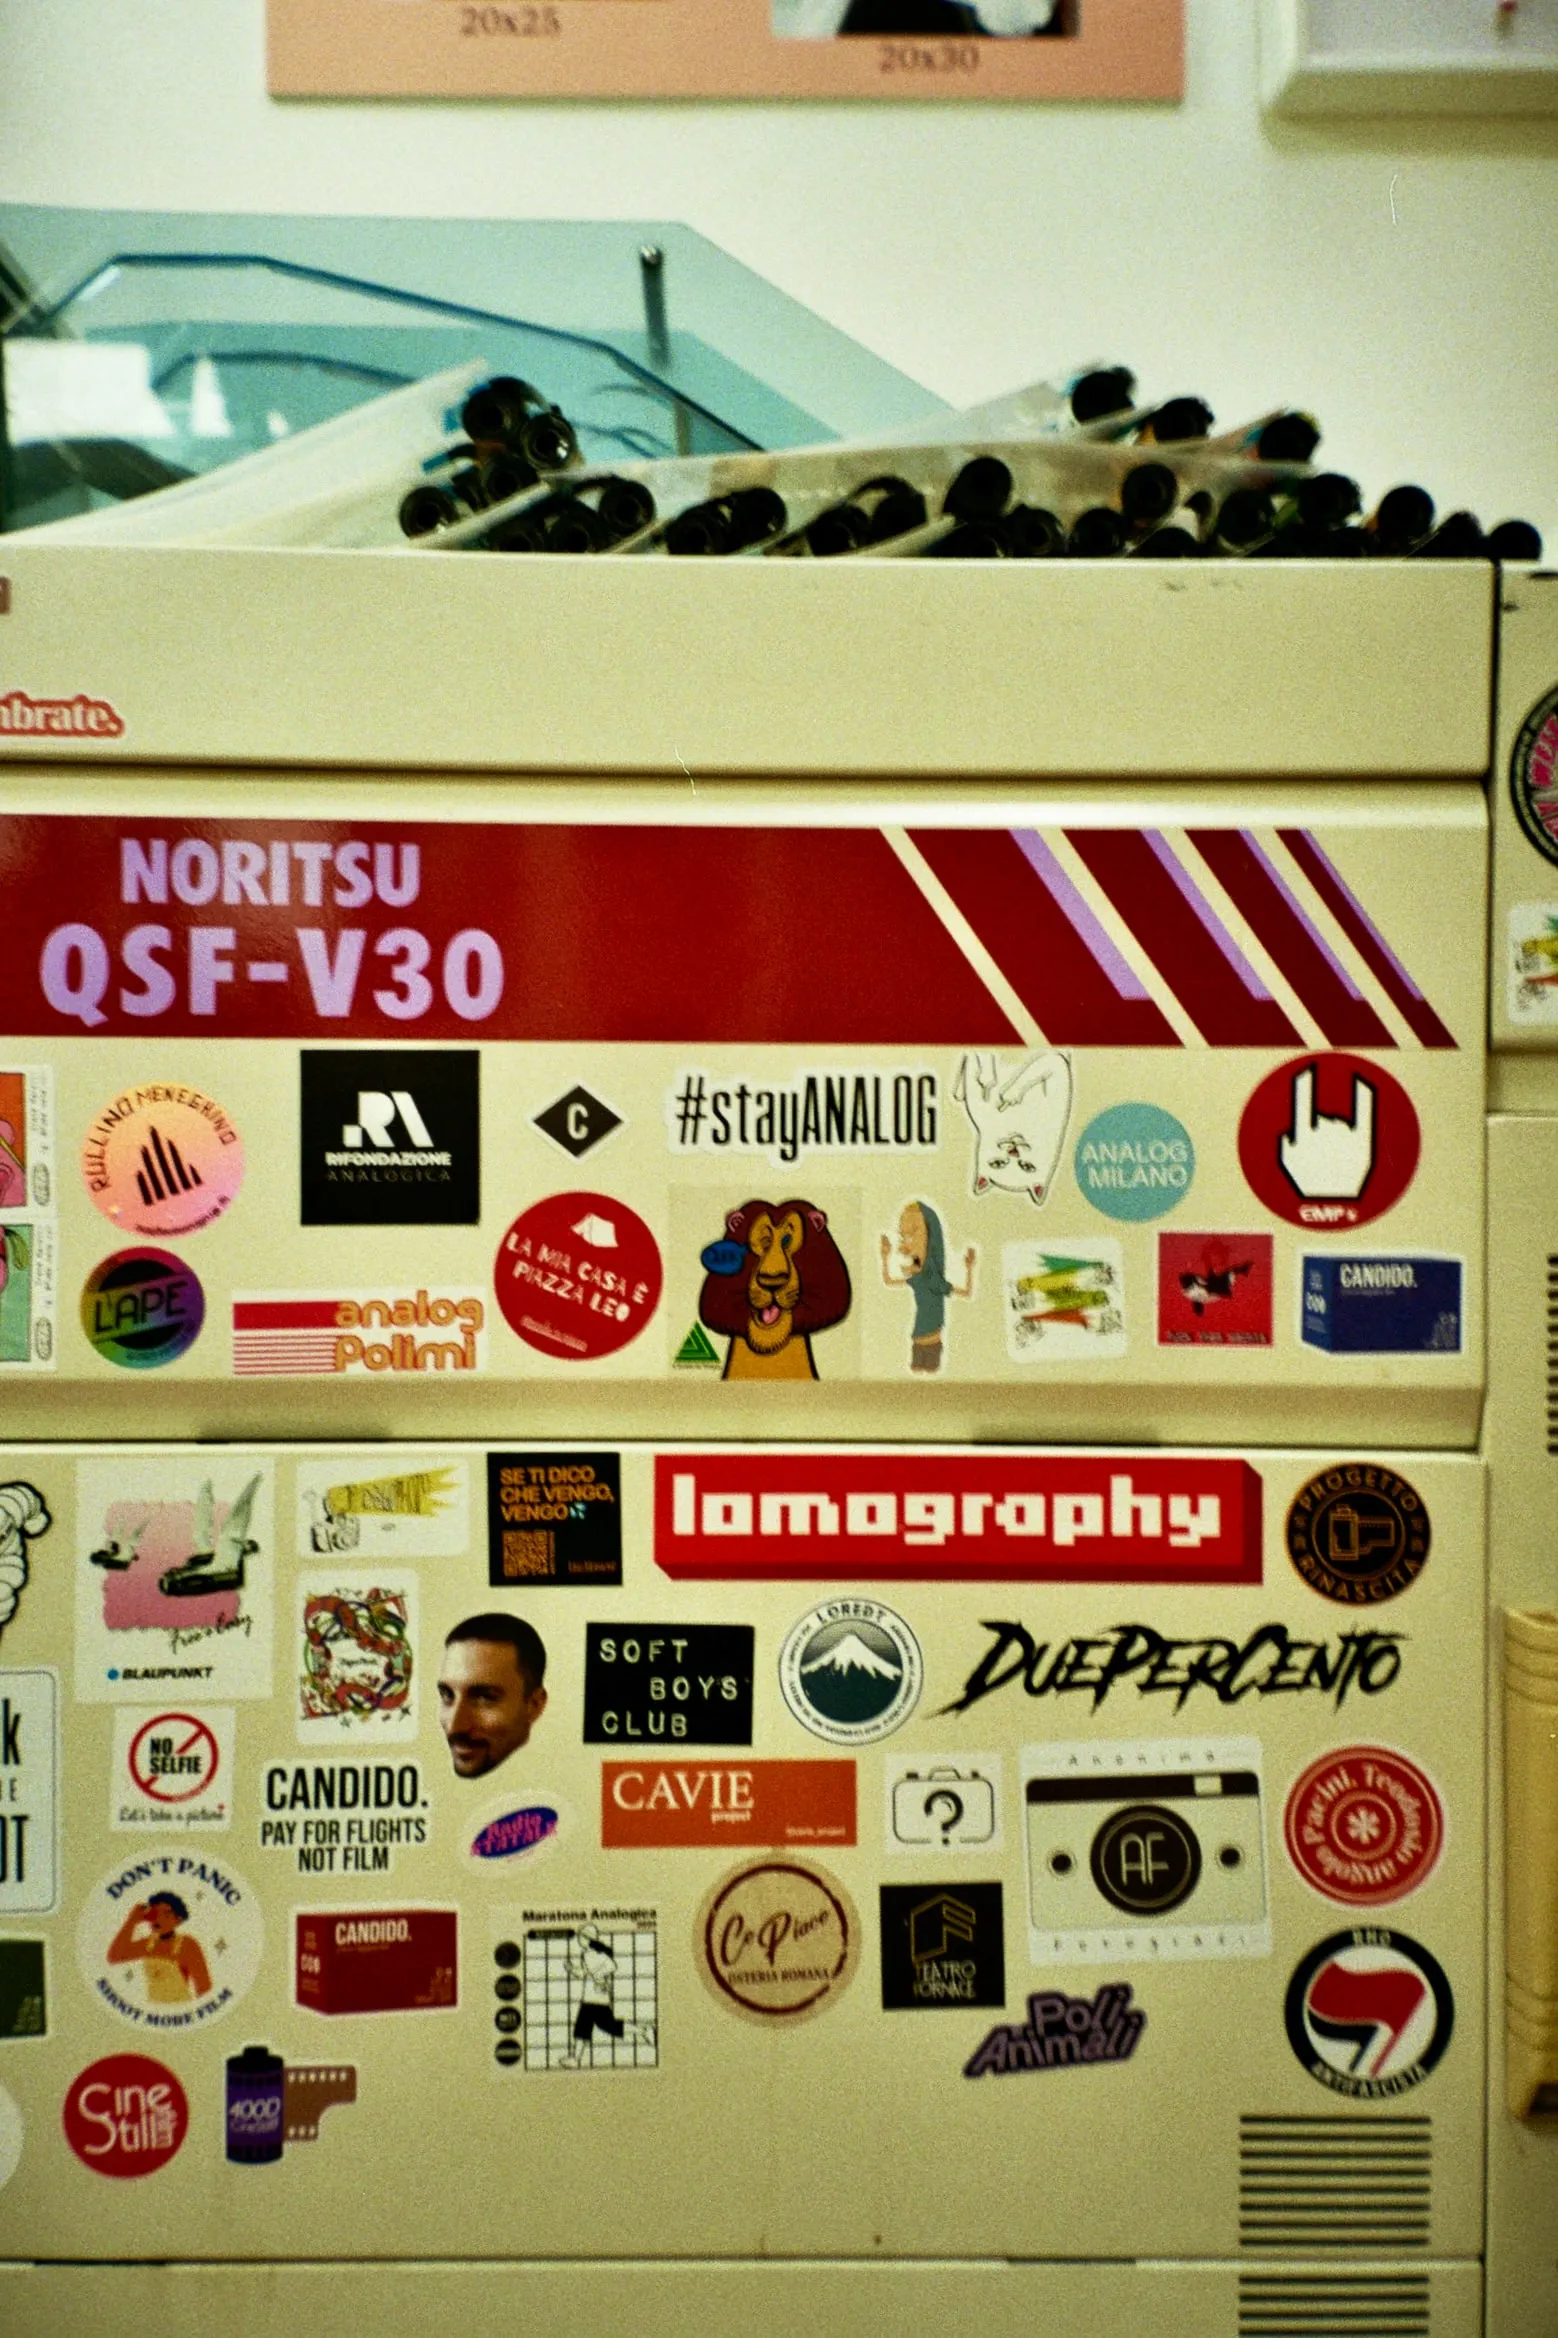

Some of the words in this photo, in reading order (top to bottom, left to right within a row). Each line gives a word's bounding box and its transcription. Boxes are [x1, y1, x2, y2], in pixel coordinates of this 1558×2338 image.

[460, 6, 561, 37] 20x25
[880, 42, 981, 73] 20x30
[119, 838, 420, 908] NORITSU
[39, 922, 505, 1027] QSF-V30
[566, 1102, 590, 1142] C
[674, 1074, 938, 1162] #stayANALOG
[84, 1097, 135, 1193] RULLINO
[324, 1151, 452, 1167] RIFONDAZIONE
[1082, 1139, 1189, 1164] ANALOG
[326, 1168, 451, 1183] ANALOGICA
[1088, 1164, 1189, 1189] MILANO
[505, 1230, 533, 1258] LA
[537, 1242, 572, 1275] MIA
[577, 1260, 627, 1297] CASA
[1339, 1262, 1418, 1289] CANDIDO.
[512, 1259, 585, 1306] PIAZZA
[588, 1292, 631, 1323] LEO
[334, 1289, 485, 1334] analog
[500, 1466, 527, 1486] SE
[527, 1465, 546, 1485] TI
[548, 1464, 596, 1484] DICO
[1299, 1468, 1419, 1512] PROGETTO
[500, 1484, 541, 1505] CHE
[500, 1502, 569, 1522] VENGO
[672, 1472, 1222, 1548] lomography
[1300, 1555, 1421, 1601] RINASCITA
[600, 1637, 689, 1664] SOFT
[121, 1666, 214, 1680] BLAUPUNKT
[601, 1709, 688, 1738] CLUB
[150, 1738, 174, 1757] NO
[150, 1756, 202, 1775] SELFIE
[266, 1765, 430, 1811] CANDIDO.
[612, 1770, 756, 1811] CAVIE
[261, 1820, 297, 1847] PAY
[303, 1819, 341, 1845] FOR
[346, 1817, 427, 1844] FLIGHTS
[298, 1846, 338, 1872] NOT
[342, 1846, 389, 1872] FILM
[1119, 1831, 1170, 1887] AF
[106, 1855, 173, 1900] DON'T
[177, 1857, 242, 1906] PANIC
[522, 1908, 587, 1922] Maratona
[591, 1907, 657, 1922] Analogica
[335, 1917, 413, 1946] CANDIDO.
[727, 1969, 778, 1986] OSTERIA
[781, 1967, 830, 1984] ROMANA
[145, 2012, 192, 2027] MORE
[195, 1986, 234, 2019] FILM
